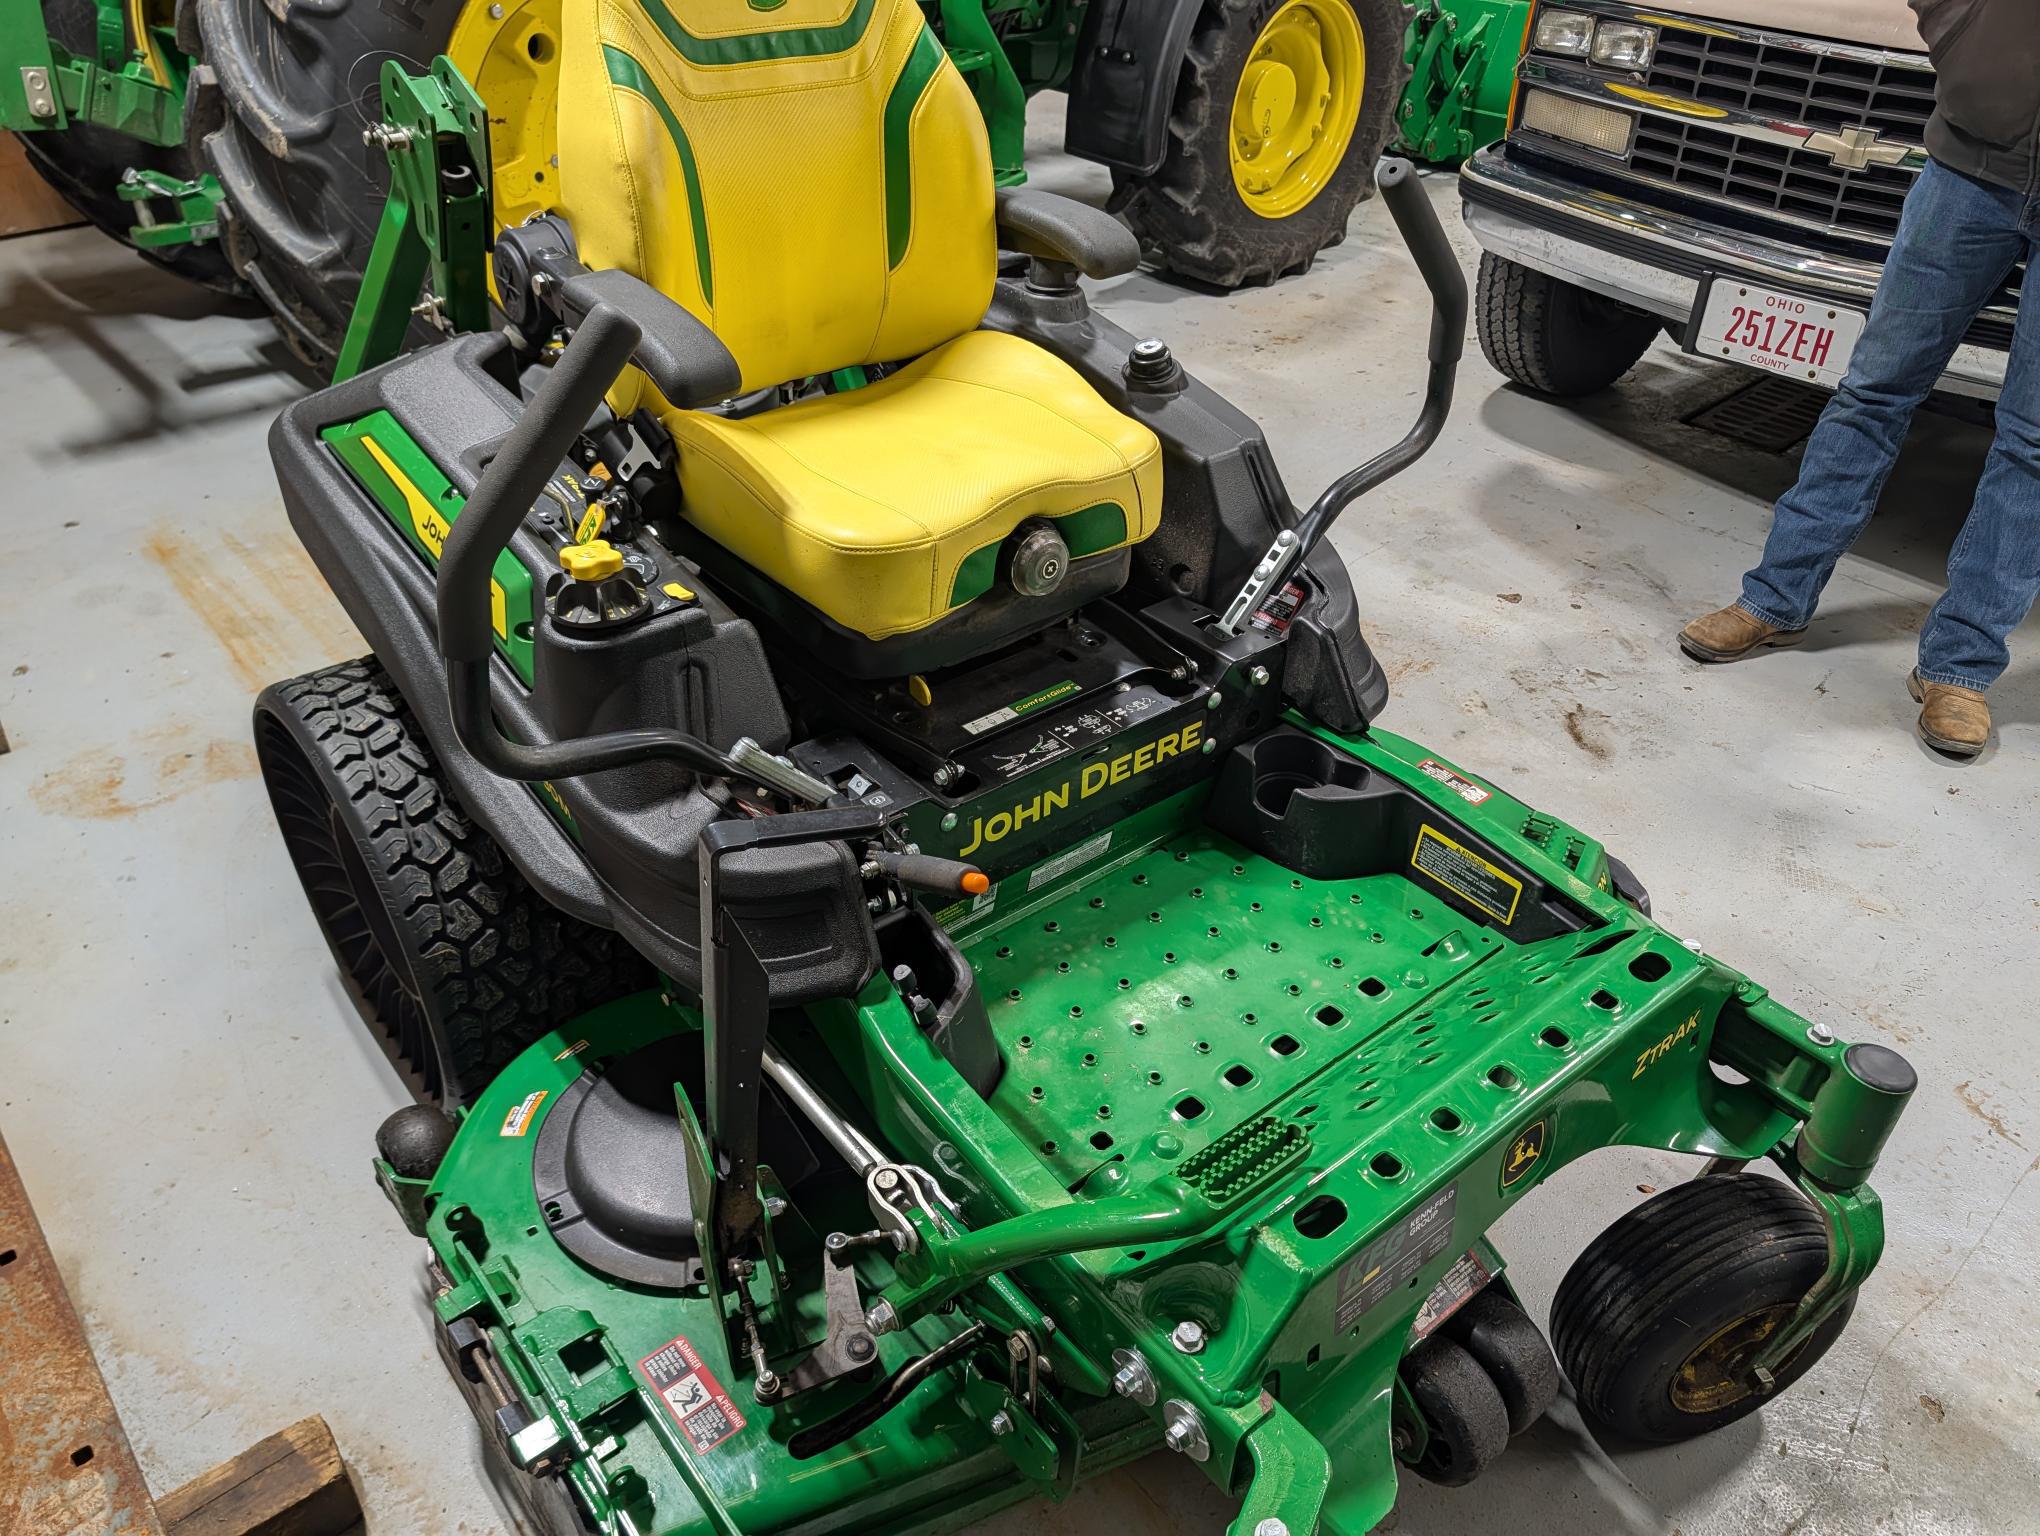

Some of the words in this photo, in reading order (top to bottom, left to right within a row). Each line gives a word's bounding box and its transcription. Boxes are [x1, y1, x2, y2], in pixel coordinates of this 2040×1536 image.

[1766, 296, 1805, 314] OHIO
[1724, 306, 1834, 367] 251ZEH
[1750, 353, 1790, 371] COUNTY
[422, 515, 447, 549] JOH
[960, 782, 1070, 857] JOHN
[1080, 720, 1203, 799] DEERE
[1631, 1008, 1701, 1081] ZTRAK
[1409, 1209, 1439, 1237] GROUP
[1410, 1189, 1455, 1227] KENN-FELD
[680, 1342, 702, 1370] DANGER
[720, 1398, 744, 1428] PELIGRO
